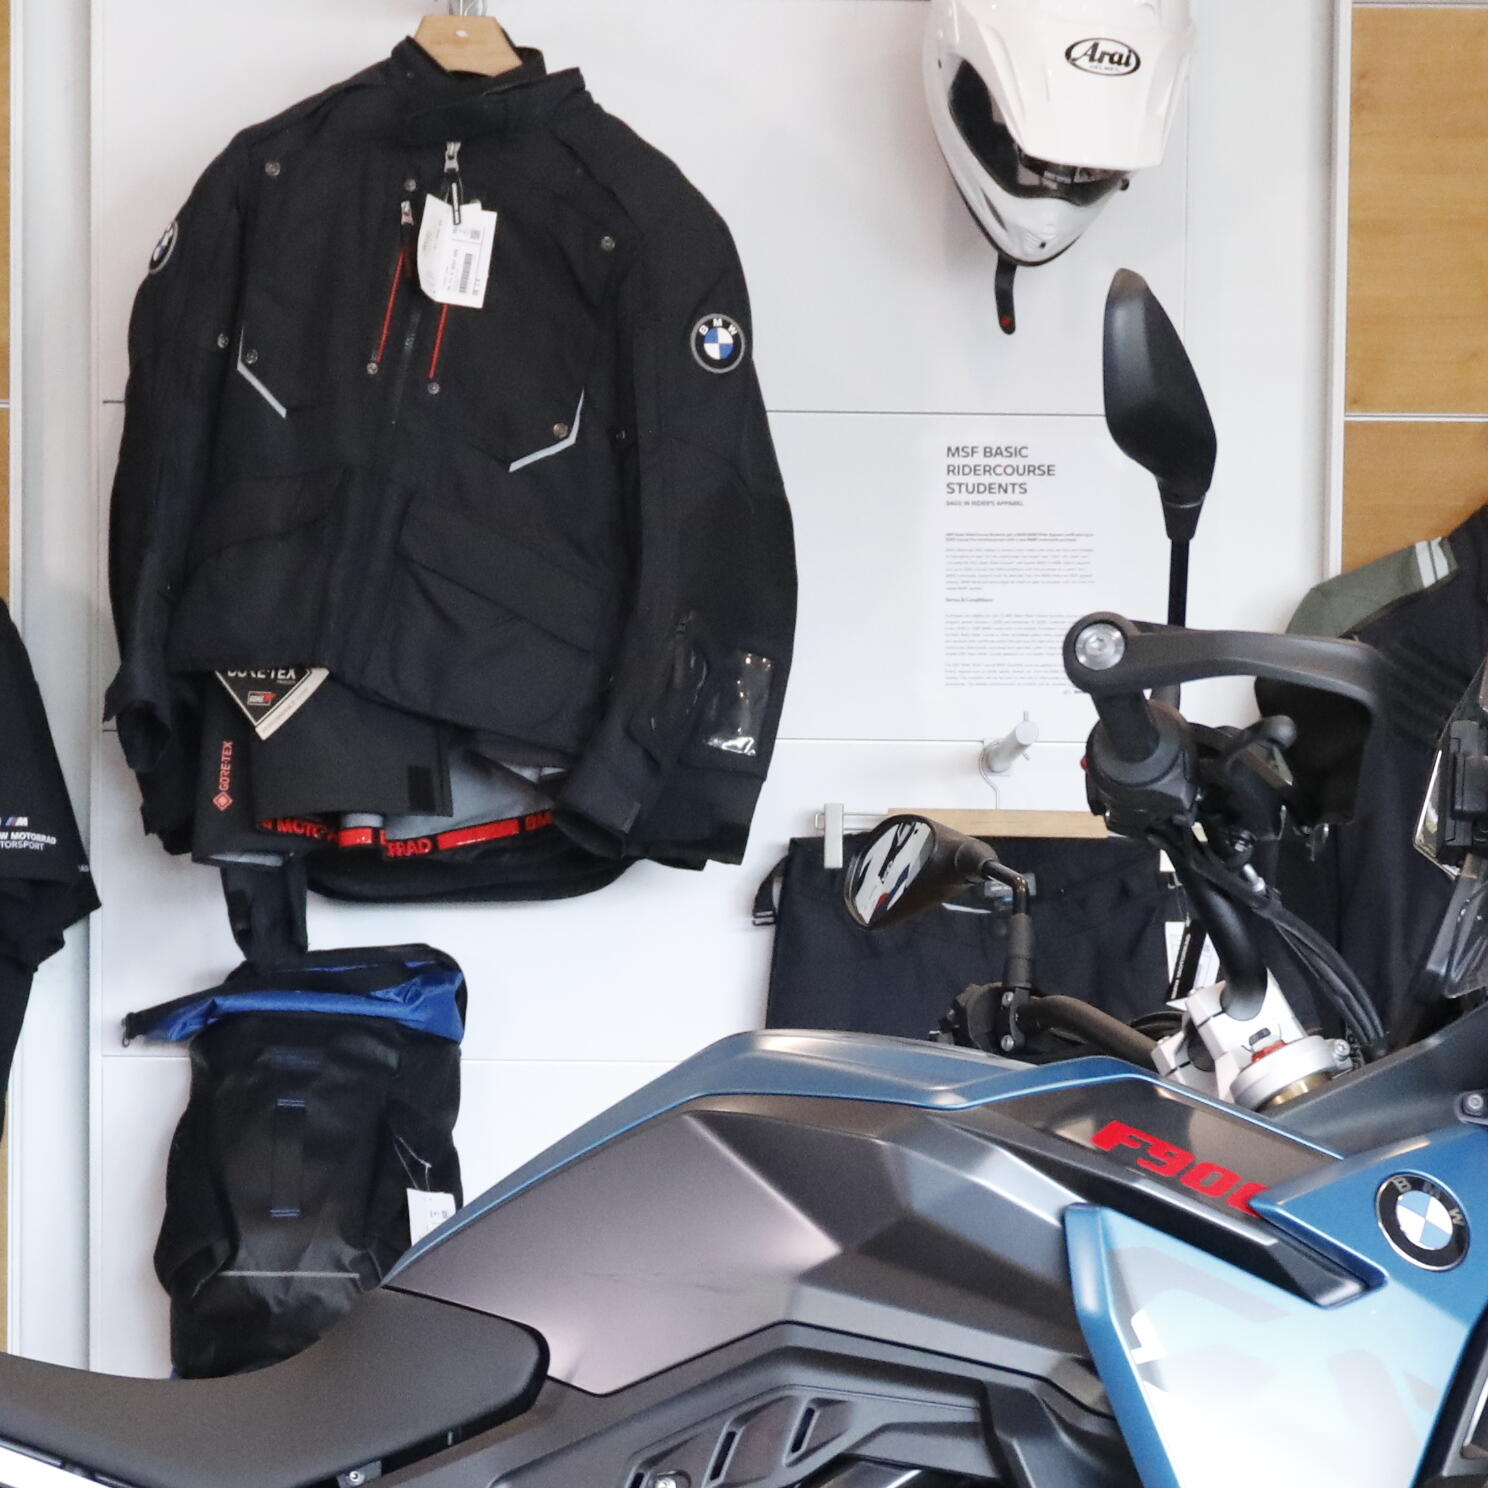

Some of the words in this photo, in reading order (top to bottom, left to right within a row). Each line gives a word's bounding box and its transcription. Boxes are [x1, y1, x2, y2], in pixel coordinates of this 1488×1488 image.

[1071, 41, 1134, 67] Arai
[946, 445, 979, 459] MSF
[983, 445, 1029, 459] BASIC
[946, 463, 1056, 477] RIDERCOURSE
[946, 482, 1028, 495] STUDENTS
[219, 740, 233, 791] GORE-TEX
[10, 831, 57, 846] MOTORRAD
[1393, 1174, 1467, 1227] BMW
